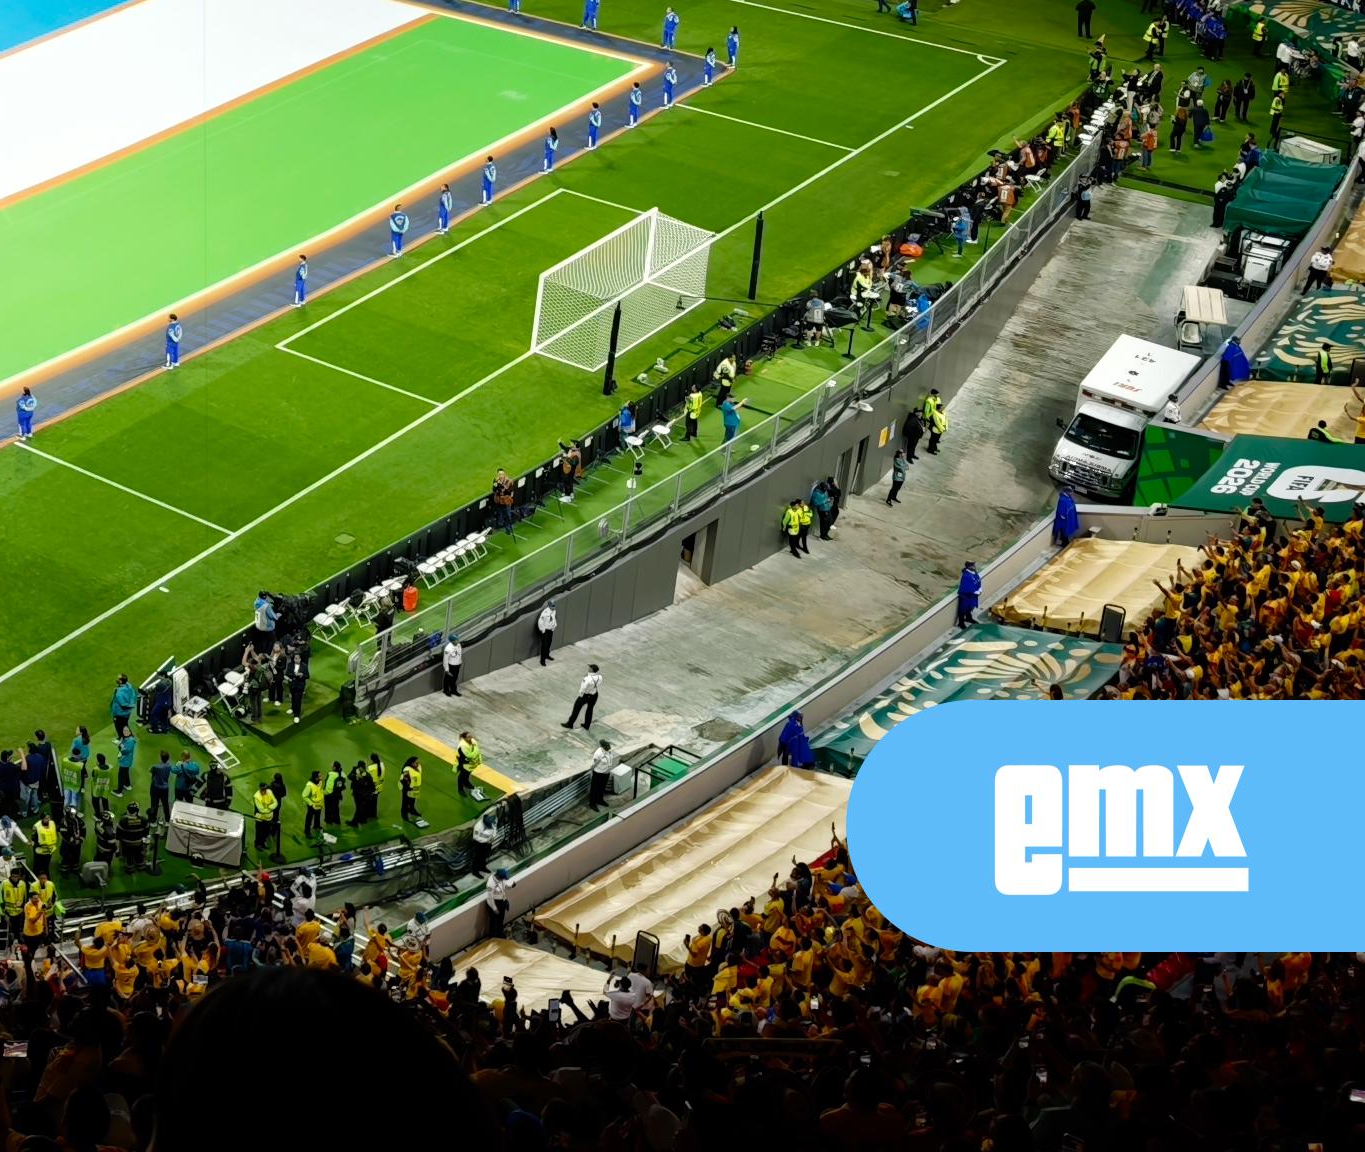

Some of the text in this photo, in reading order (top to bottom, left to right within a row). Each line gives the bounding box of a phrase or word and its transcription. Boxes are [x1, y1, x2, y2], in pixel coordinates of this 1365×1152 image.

[1210, 458, 1260, 494] 2026
[1251, 462, 1281, 484] WORLD
[1285, 475, 1314, 491] FIFA
